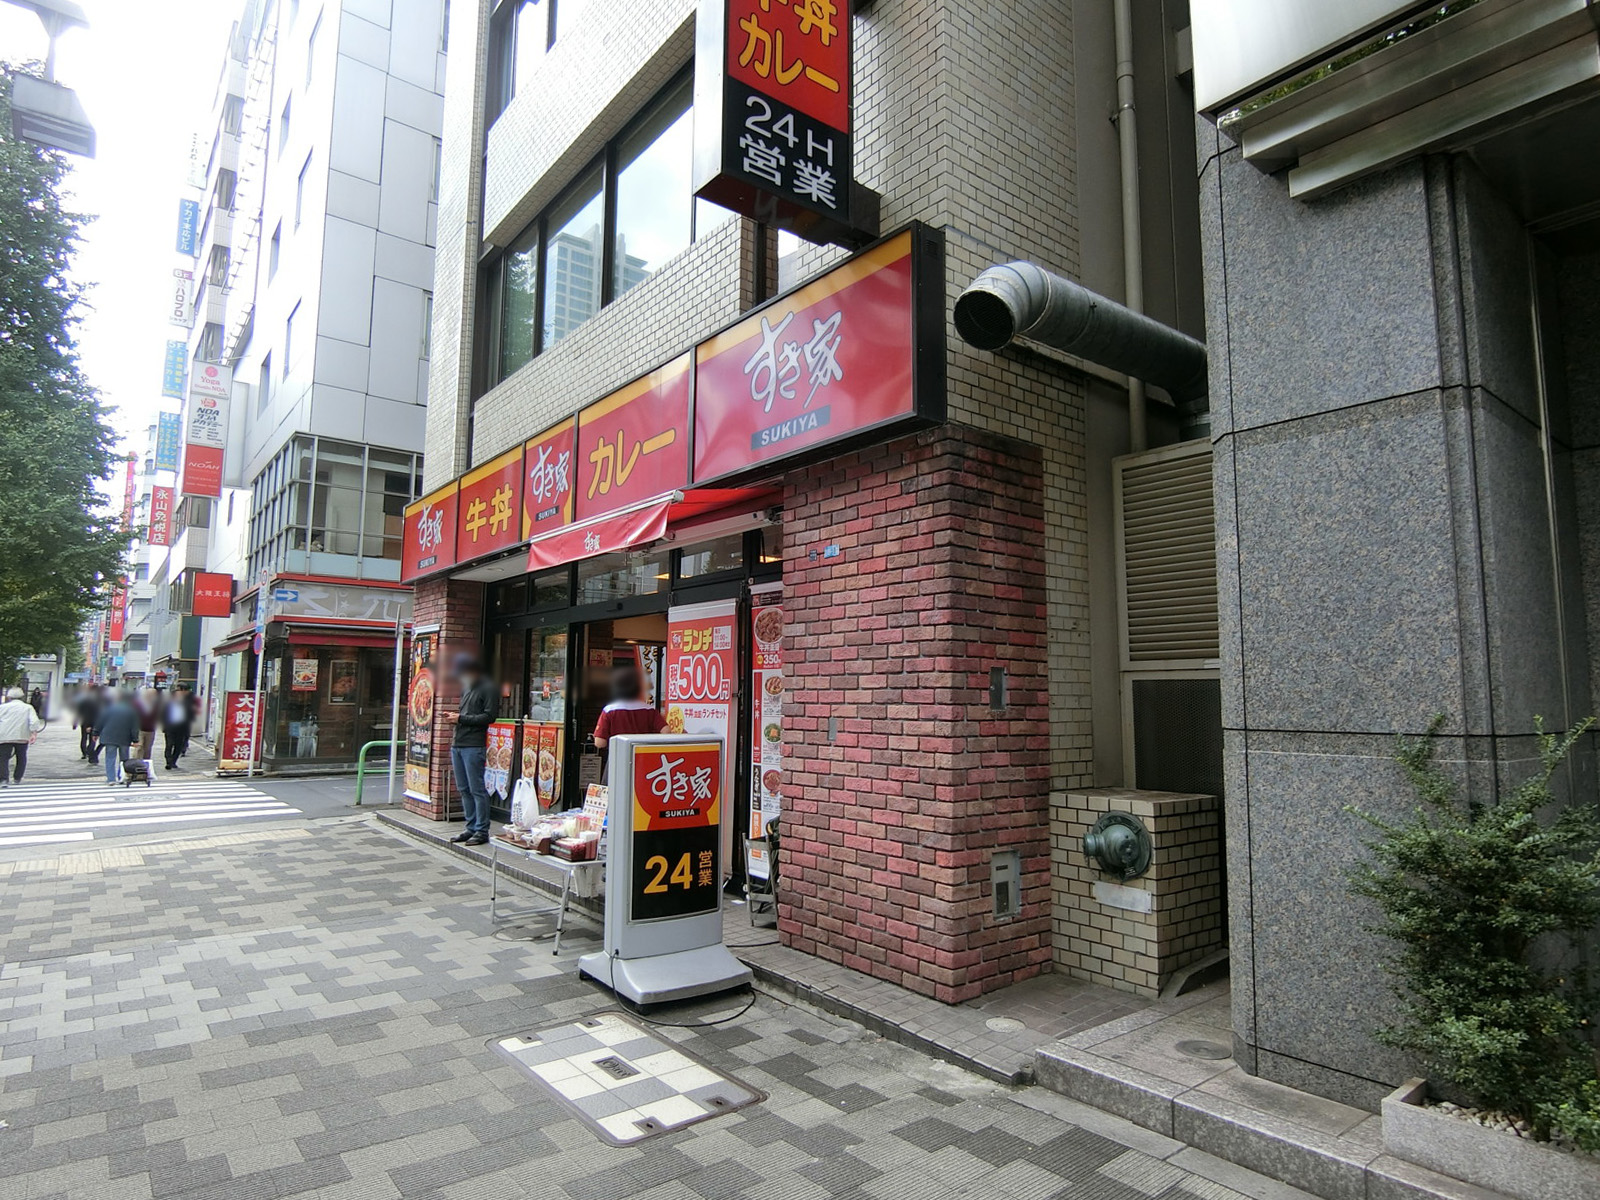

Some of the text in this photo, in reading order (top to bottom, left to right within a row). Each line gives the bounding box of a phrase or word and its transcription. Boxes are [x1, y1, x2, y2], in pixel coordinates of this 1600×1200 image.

[758, 0, 838, 46] 丼
[738, 13, 840, 93] カレー
[745, 95, 834, 167] 24H
[739, 134, 837, 210] 営業
[201, 375, 220, 386] Yoga
[743, 310, 844, 413] すき家
[197, 407, 219, 416] NOA
[761, 412, 818, 446] SUKIYA
[530, 445, 570, 505] すき家
[587, 428, 677, 500] カレー
[152, 489, 168, 544] 永山免税店
[417, 501, 444, 553] すき家
[465, 482, 514, 543] 牛丼
[538, 507, 557, 521] SUKIYA
[583, 530, 601, 552] すき家
[195, 589, 230, 599] 大阪王将
[683, 627, 713, 652] ランチ
[669, 664, 679, 699] 税込
[232, 694, 254, 760] 大阪王将
[646, 753, 712, 807] すき家
[665, 808, 695, 818] SUKIYA
[643, 852, 693, 895] 24
[698, 850, 713, 887] 営業
